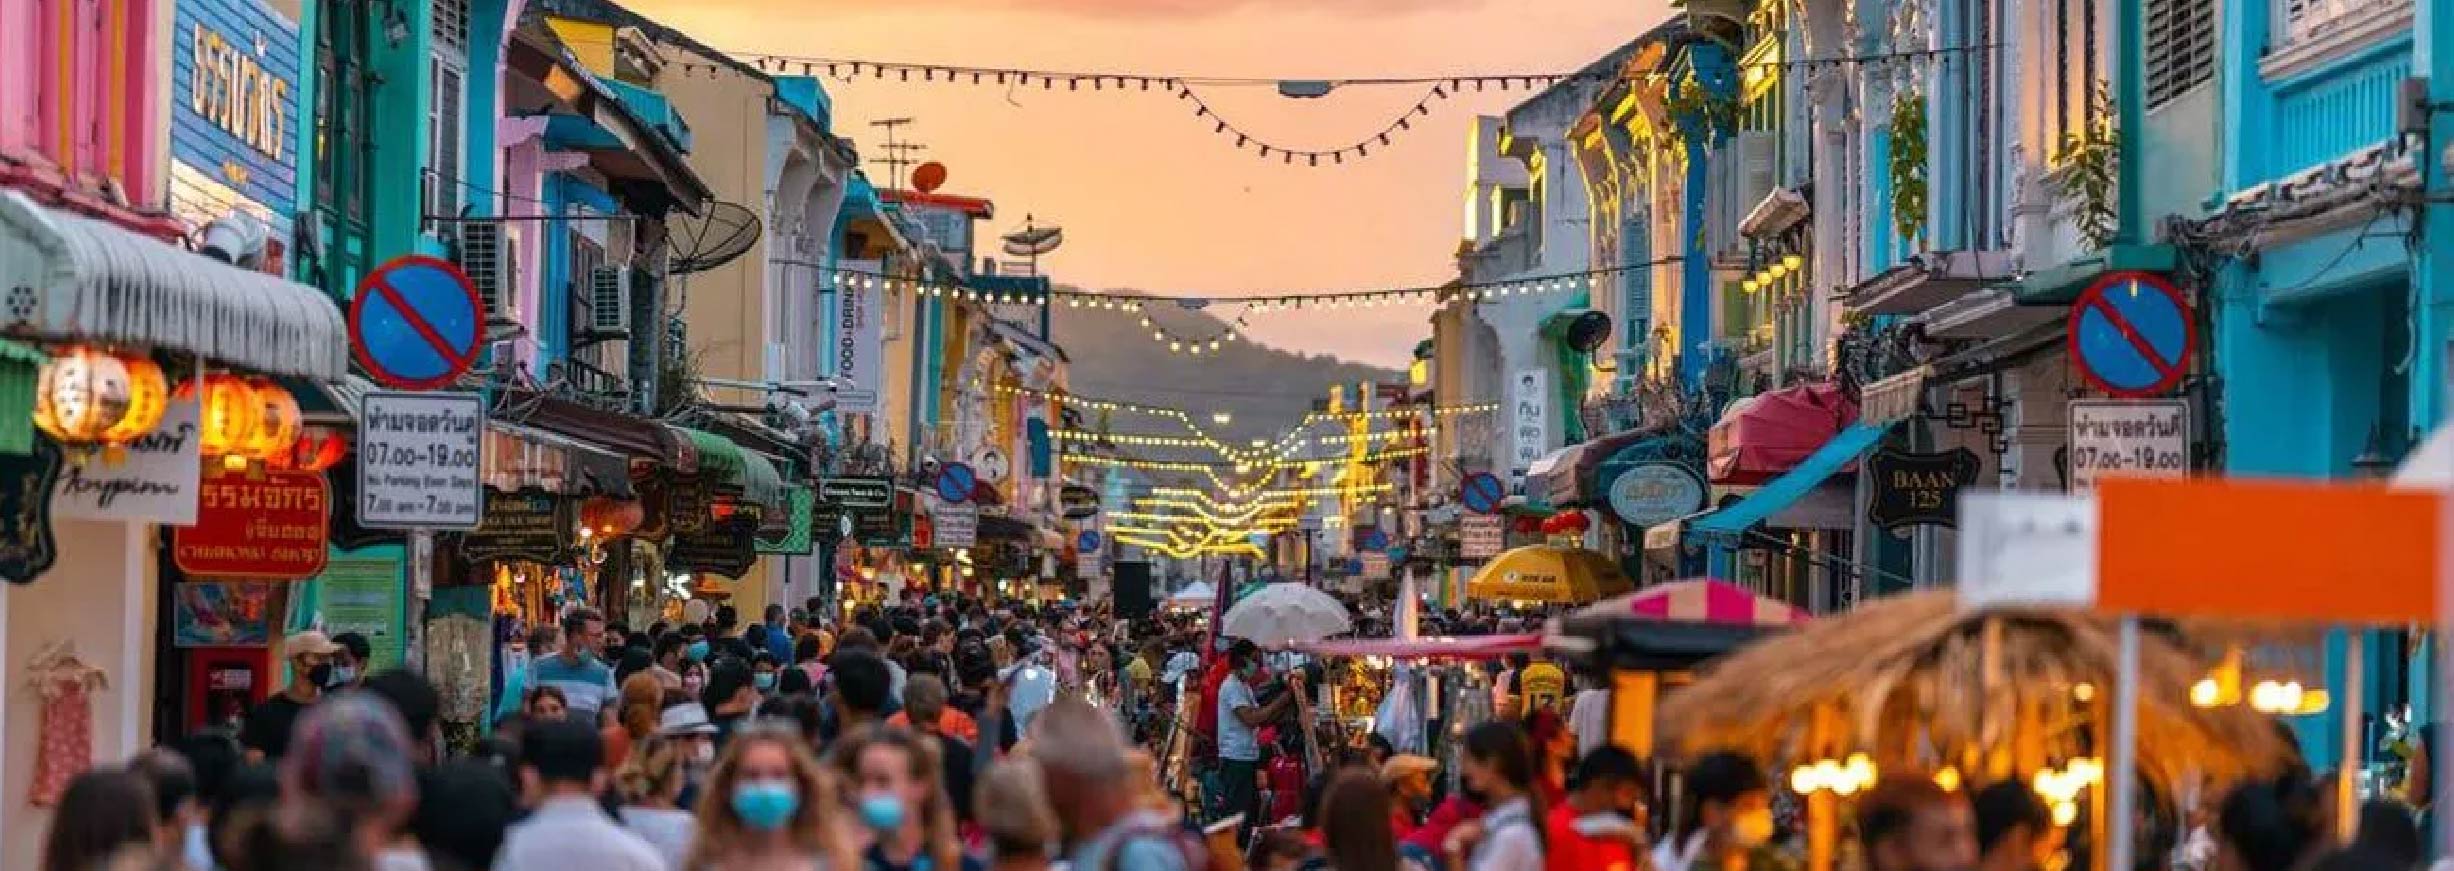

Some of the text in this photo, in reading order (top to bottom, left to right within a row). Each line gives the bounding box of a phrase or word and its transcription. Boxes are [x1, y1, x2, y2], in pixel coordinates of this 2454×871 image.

[367, 441, 475, 468] 07.00-19.00
[2075, 446, 2181, 468] 07.00-19.00
[1893, 470, 1956, 489] BAAN
[203, 476, 320, 510] รรมจักร
[1911, 490, 1941, 508] 125
